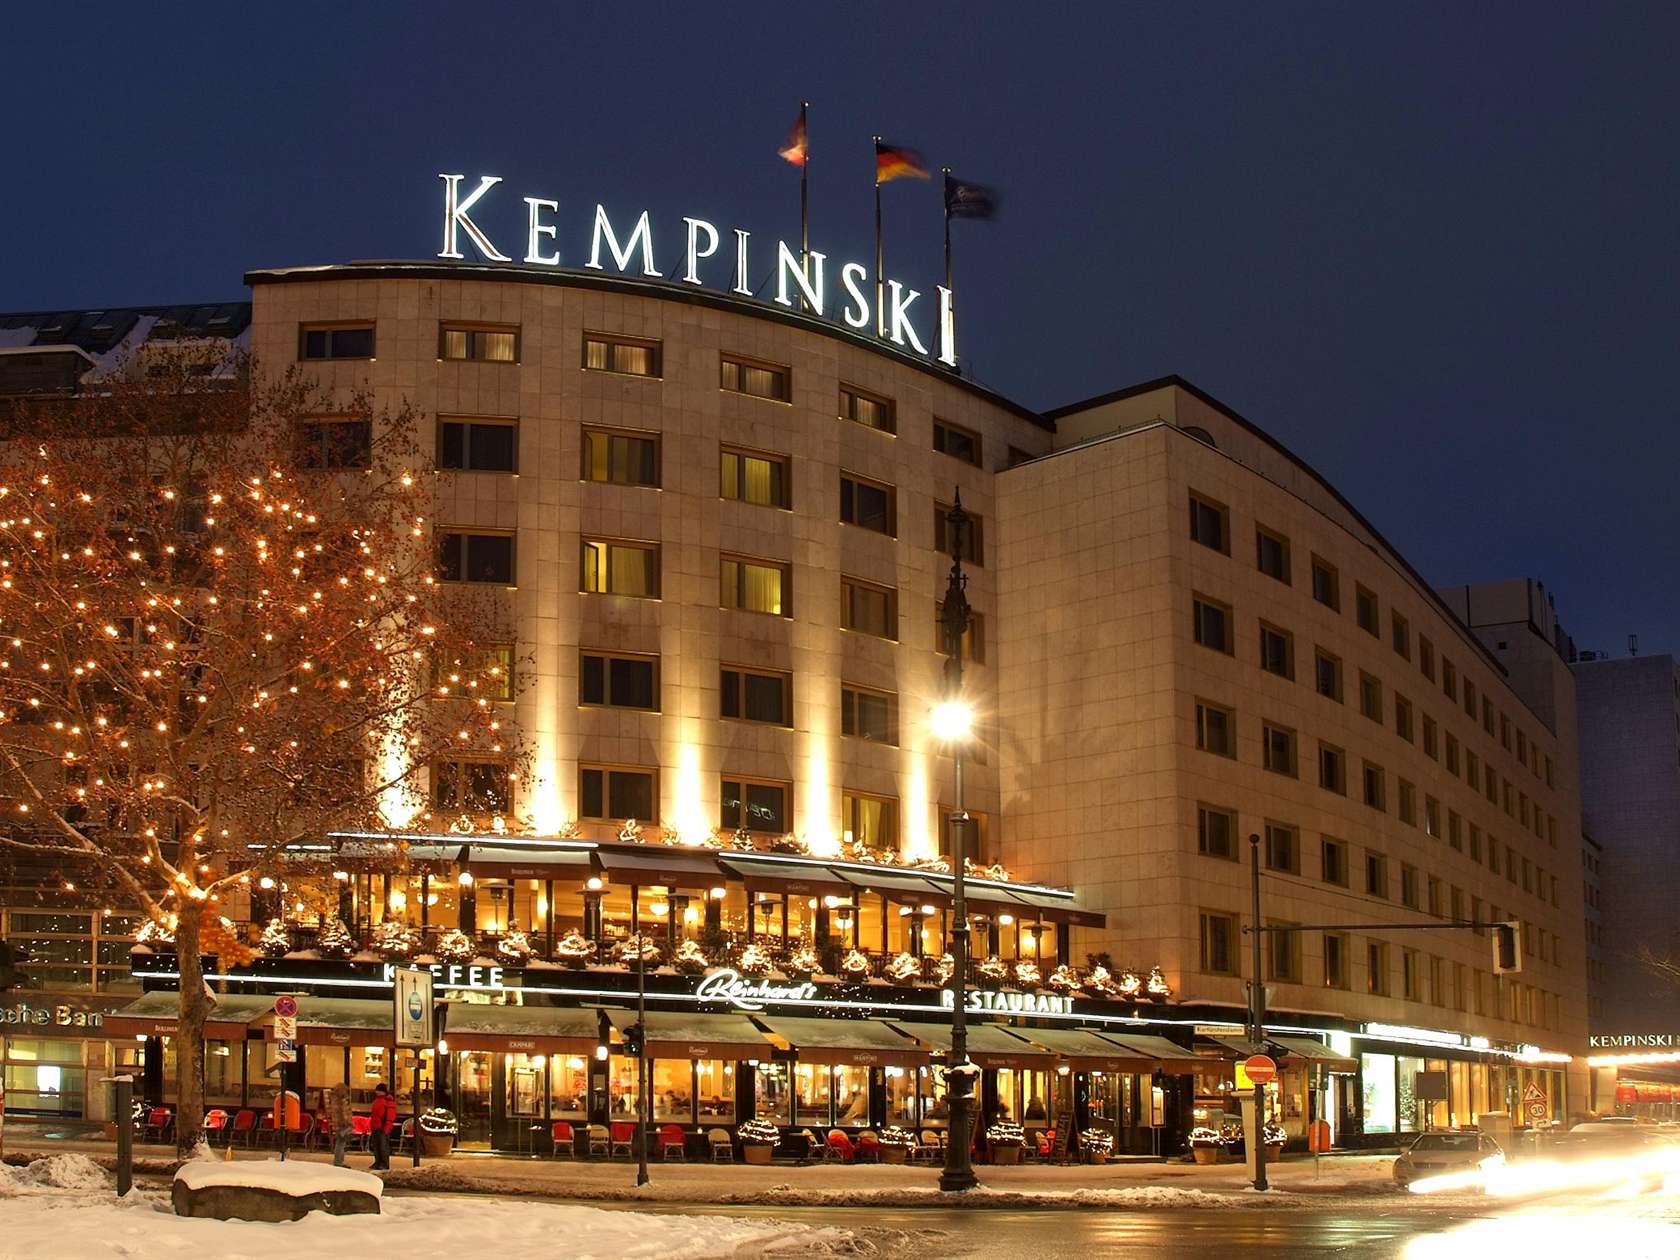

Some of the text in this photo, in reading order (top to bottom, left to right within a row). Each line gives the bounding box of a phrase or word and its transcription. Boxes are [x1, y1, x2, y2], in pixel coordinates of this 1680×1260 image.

[437, 172, 957, 368] KEMPINSKI
[383, 962, 504, 988] KFFEE
[696, 968, 817, 1010] Reinhard's
[940, 989, 1075, 1014] RSTAURANT
[1589, 1034, 1672, 1047] KEMPINSKI
[1532, 1105, 1543, 1114] 30
